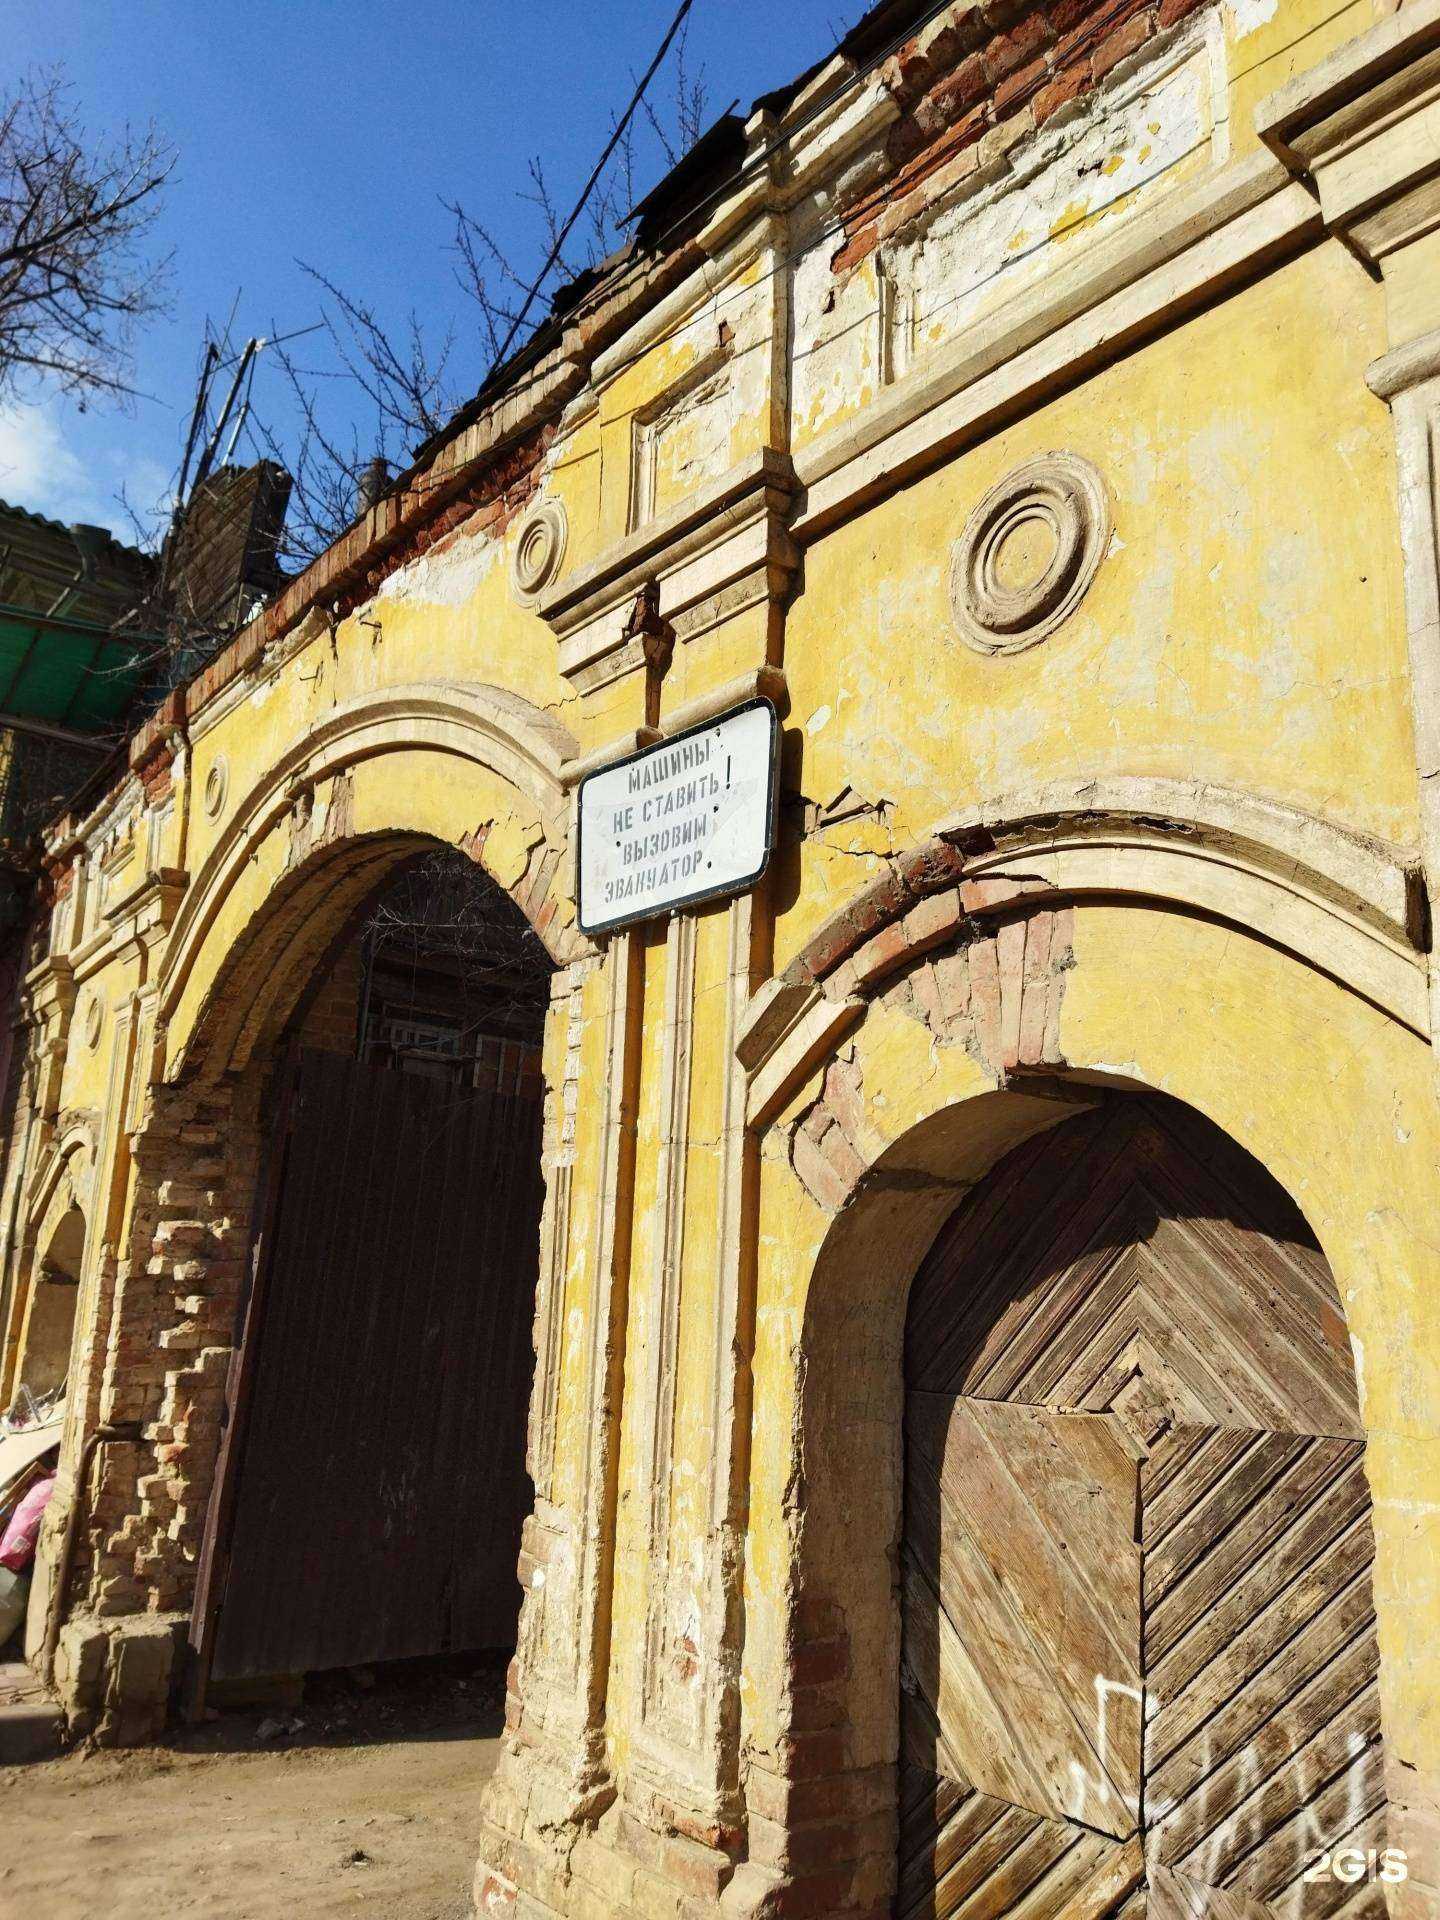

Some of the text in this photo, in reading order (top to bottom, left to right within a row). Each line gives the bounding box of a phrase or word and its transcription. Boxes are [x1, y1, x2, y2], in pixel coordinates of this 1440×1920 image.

[628, 738, 711, 794] МАШИНЫ
[613, 806, 633, 834] НЕ
[623, 813, 707, 865] ВЫЗОВИМ
